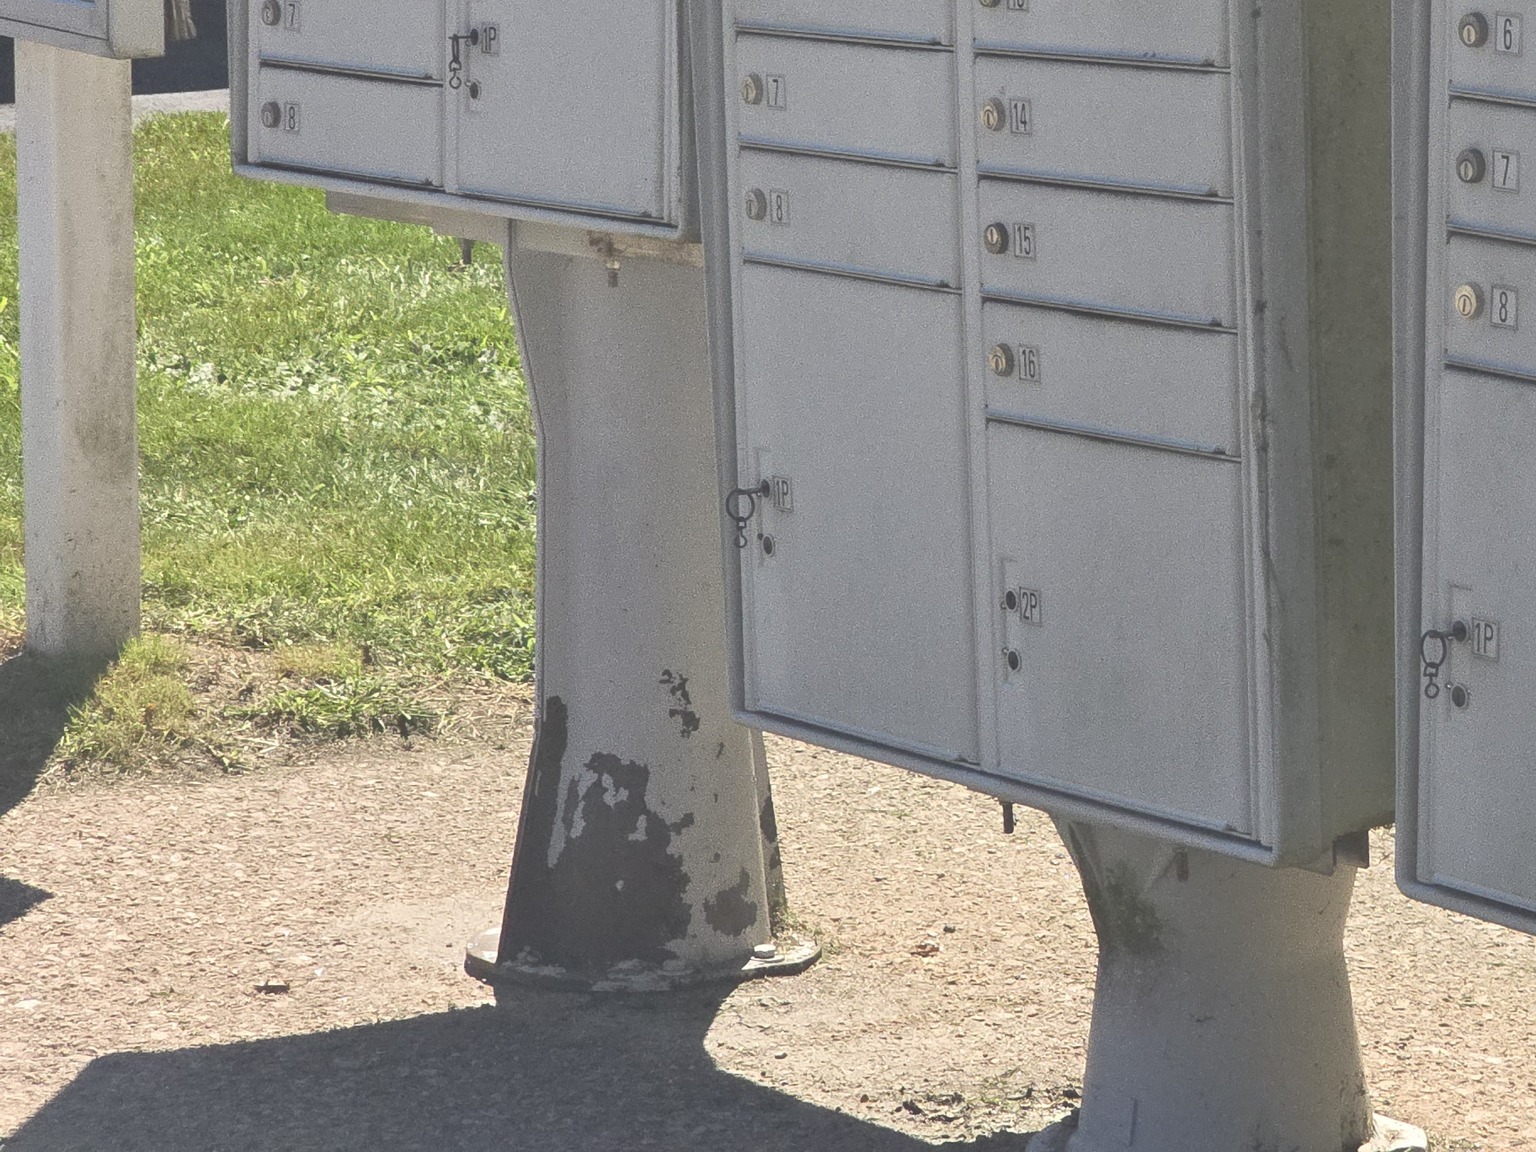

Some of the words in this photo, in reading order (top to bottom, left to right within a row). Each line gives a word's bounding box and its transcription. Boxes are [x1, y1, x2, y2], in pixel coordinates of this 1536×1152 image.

[483, 26, 497, 53] 1P
[1503, 18, 1512, 50] 6
[1014, 103, 1027, 132] 14
[1501, 155, 1510, 186] 7
[1017, 226, 1030, 255] 15
[1499, 291, 1508, 323] 8
[1022, 349, 1035, 378] 16
[776, 479, 789, 507] 1P
[1022, 592, 1037, 621] 2P
[1475, 622, 1494, 653] 1P
